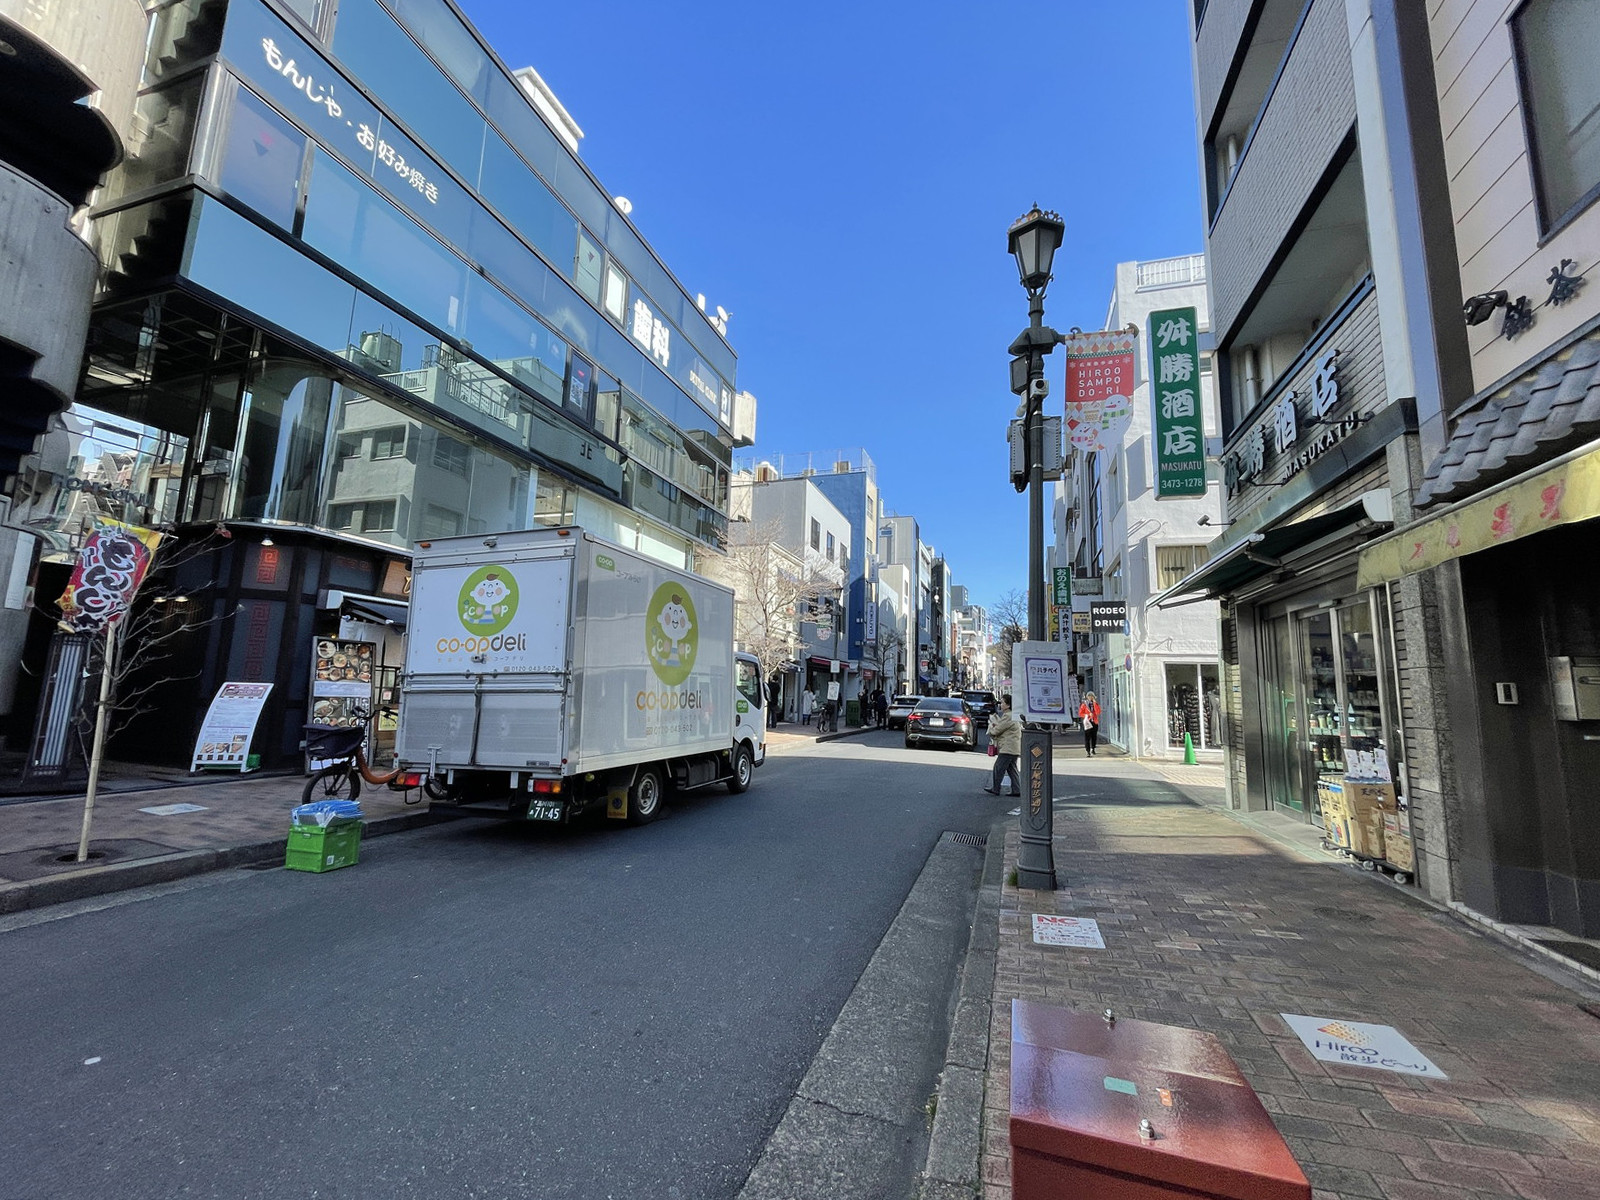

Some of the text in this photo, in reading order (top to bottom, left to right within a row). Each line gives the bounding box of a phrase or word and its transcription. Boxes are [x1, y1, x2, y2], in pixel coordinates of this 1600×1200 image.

[1079, 366, 1121, 378] HIROO
[1078, 376, 1121, 388] SAMPO
[1078, 386, 1119, 397] DO-RI
[1284, 411, 1358, 478] MASUKATU
[1161, 460, 1202, 472] MASUKATU
[1161, 478, 1203, 489] 3473-1278
[1092, 607, 1126, 615] RODEO
[1094, 619, 1125, 627] DRIVE
